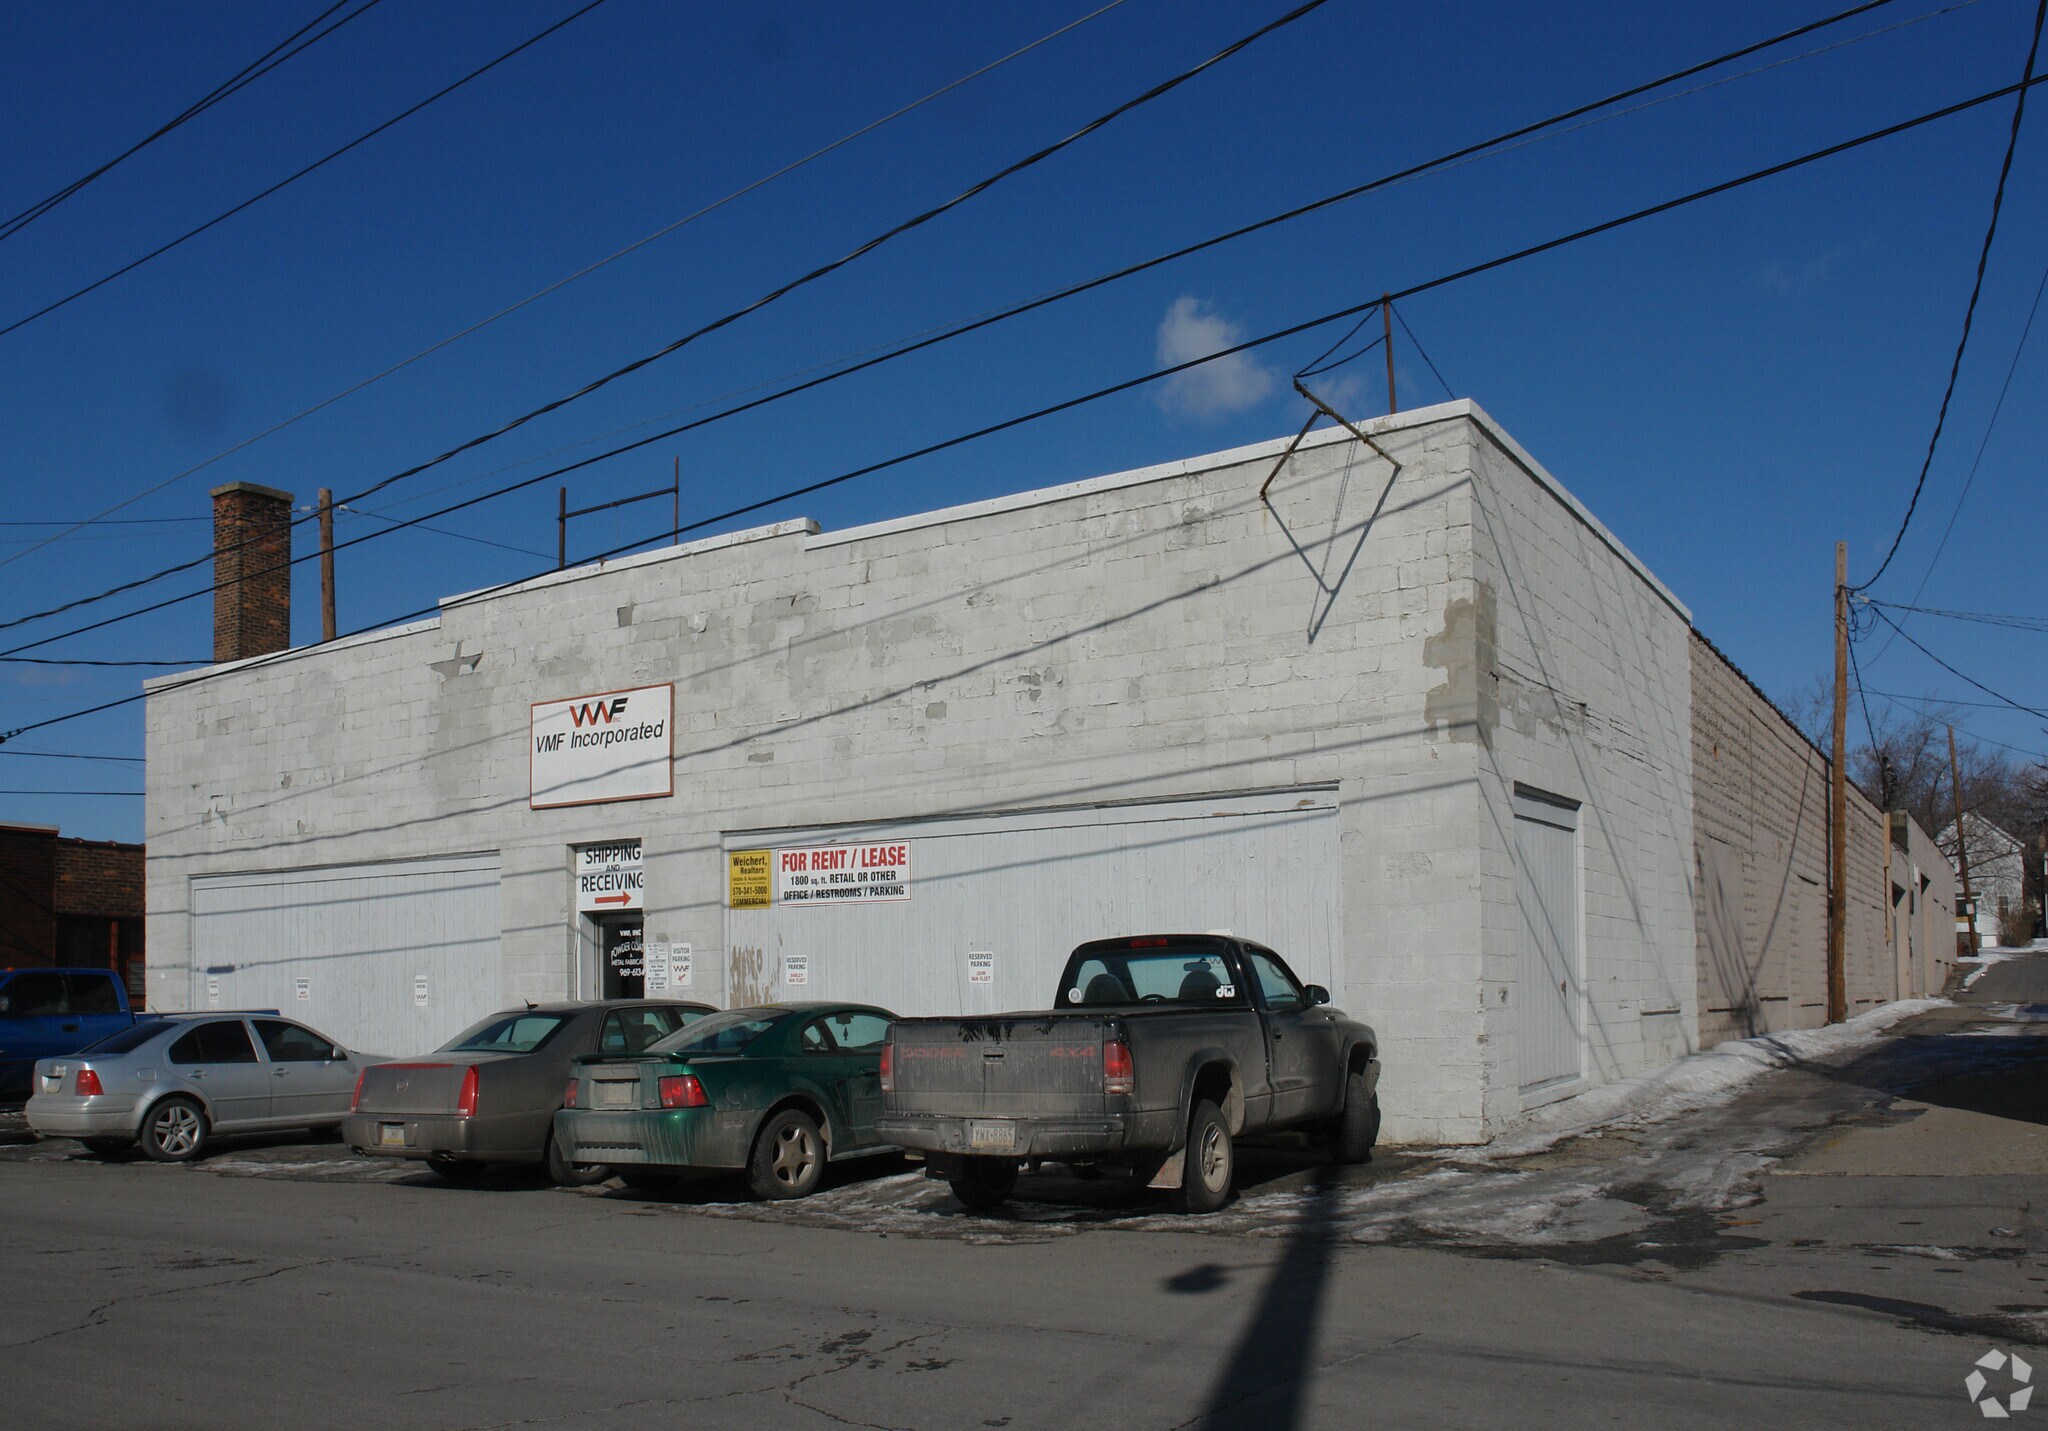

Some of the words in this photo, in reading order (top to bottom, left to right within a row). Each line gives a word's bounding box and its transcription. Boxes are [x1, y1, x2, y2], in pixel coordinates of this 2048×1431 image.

[536, 732, 566, 754] VMF
[570, 720, 664, 749] Incorporated
[585, 843, 642, 865] SHIPPING
[732, 856, 768, 867] Weichert,
[781, 852, 807, 873] FOR
[811, 849, 847, 870] RENT
[850, 848, 858, 869] /
[861, 845, 906, 868] LEASE
[606, 864, 620, 872] AND
[581, 872, 644, 893] RECEIVING
[790, 875, 809, 886] 1800
[810, 878, 820, 887] sq.
[820, 876, 828, 885] ft.
[829, 873, 855, 884] RETAIL
[857, 872, 868, 882] OR
[870, 870, 897, 882] OTHER
[732, 886, 768, 896] 570-341-5000
[783, 889, 809, 900] OFFICE
[810, 889, 815, 900] /
[815, 887, 862, 899] RESTROOMS
[863, 887, 868, 898] /
[869, 885, 905, 897] PARKING
[732, 897, 768, 906] COMMERCIAL
